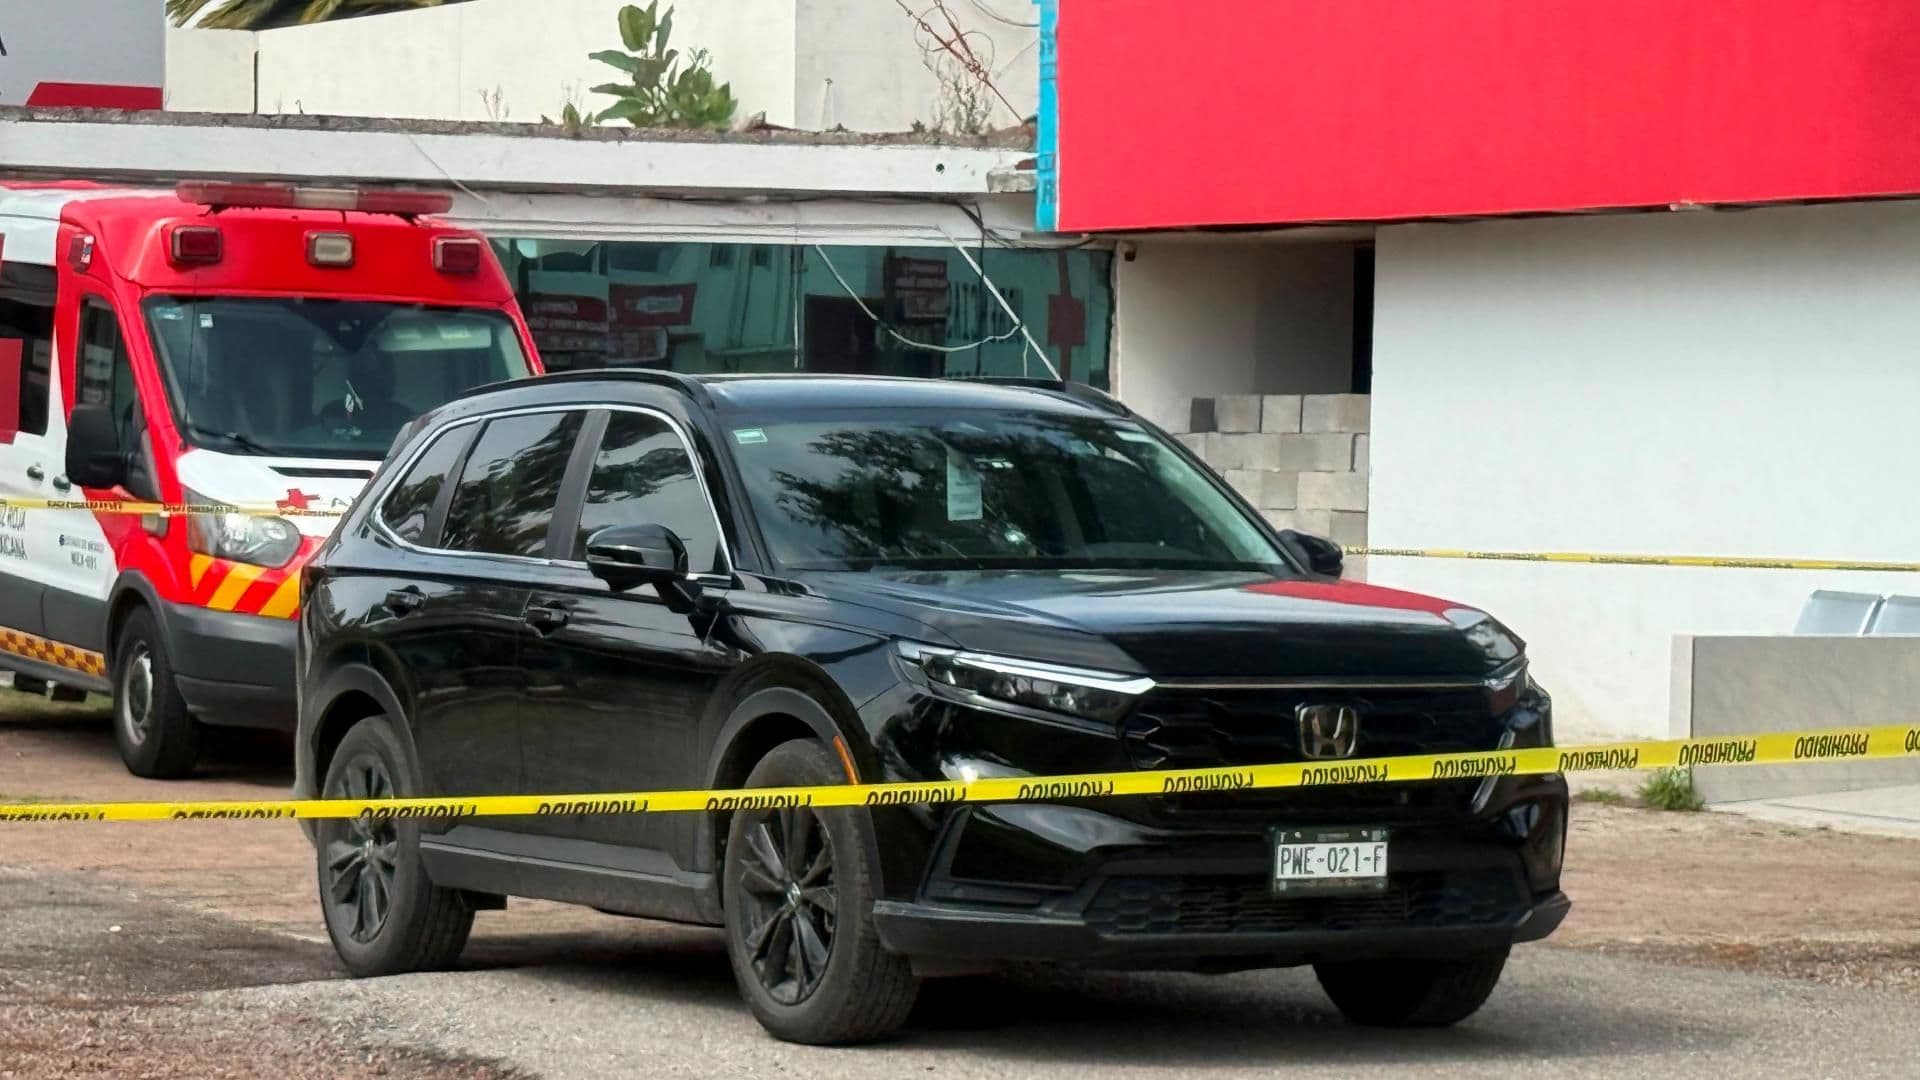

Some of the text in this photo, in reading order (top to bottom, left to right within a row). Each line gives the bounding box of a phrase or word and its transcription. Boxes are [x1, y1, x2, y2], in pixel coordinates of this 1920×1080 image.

[1558, 747, 1639, 772] PROHIBIDO
[1678, 739, 1758, 767] PROHIBIDO
[1794, 733, 1870, 759] PROHIBIDO
[1280, 844, 1385, 875] PWE-021-F
